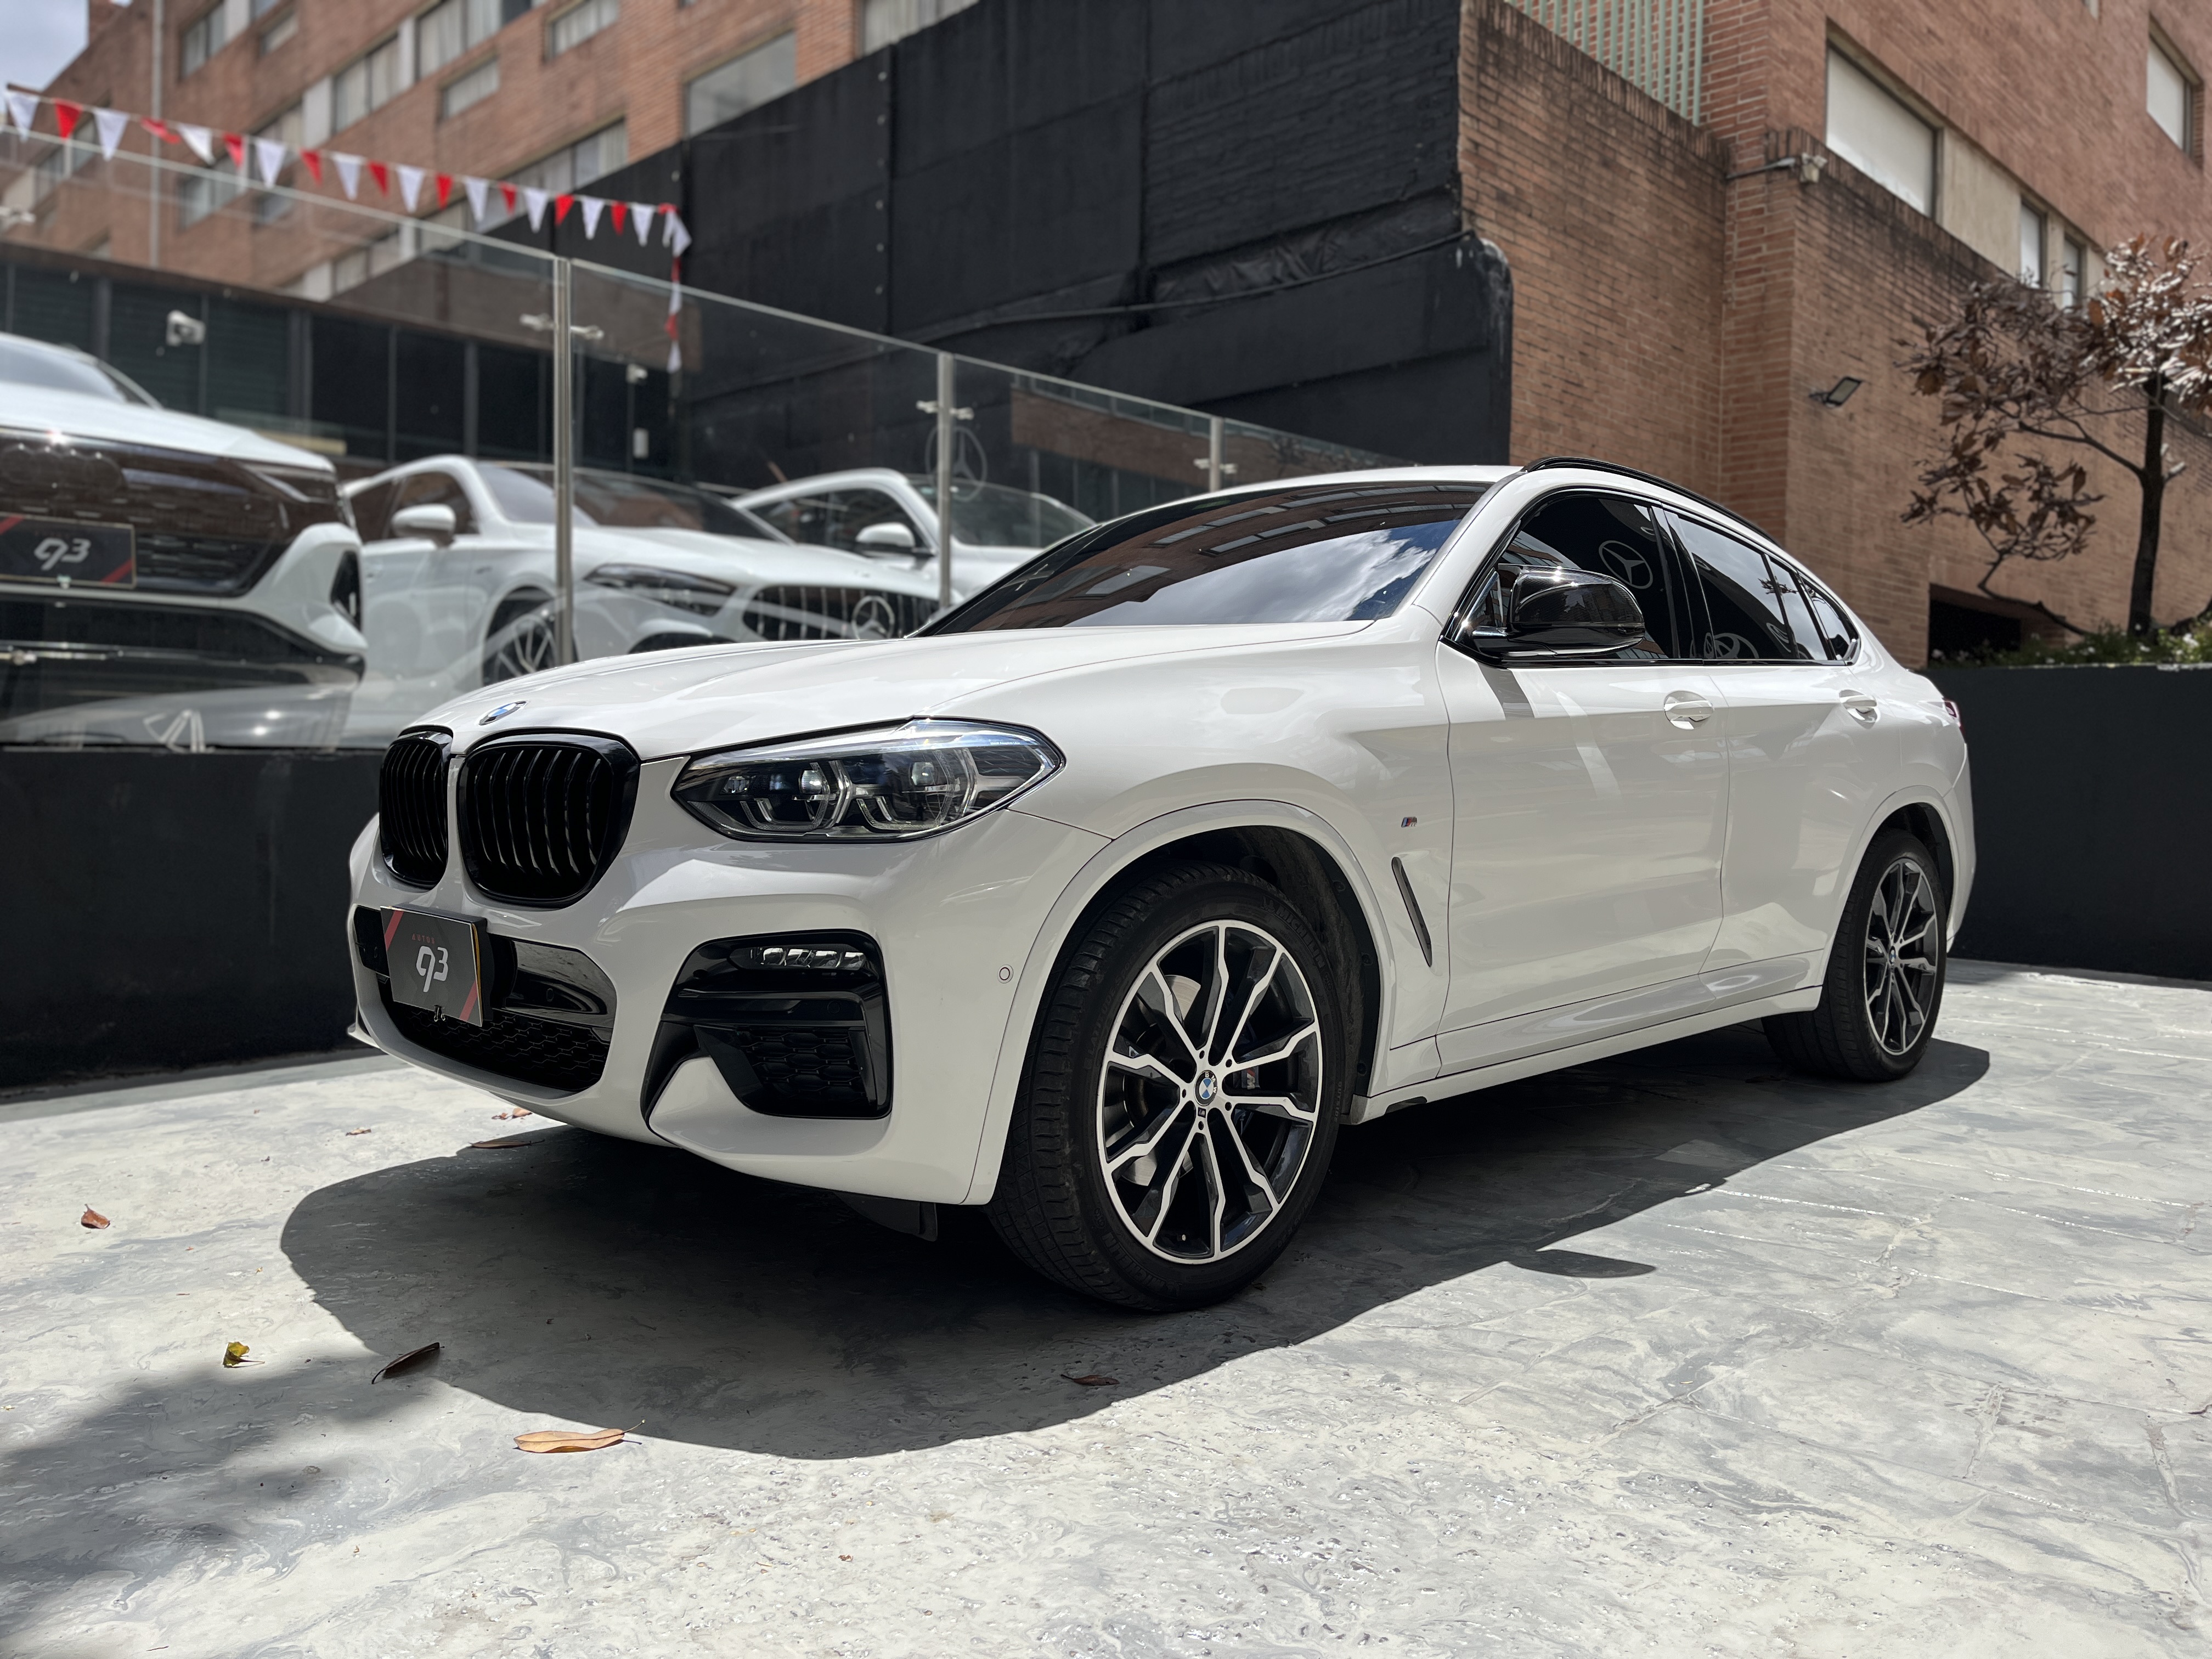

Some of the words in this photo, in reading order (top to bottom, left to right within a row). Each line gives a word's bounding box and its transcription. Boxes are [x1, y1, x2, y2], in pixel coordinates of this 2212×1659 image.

[411, 933, 435, 944] AUTOS
[1276, 906, 1325, 969] MICHELIN
[1087, 986, 1115, 1055] LATITUDE
[1204, 1071, 1217, 1093] BMW
[1333, 1081, 1342, 1123] OUTSIDE
[1101, 1232, 1166, 1289] MICHELIN
